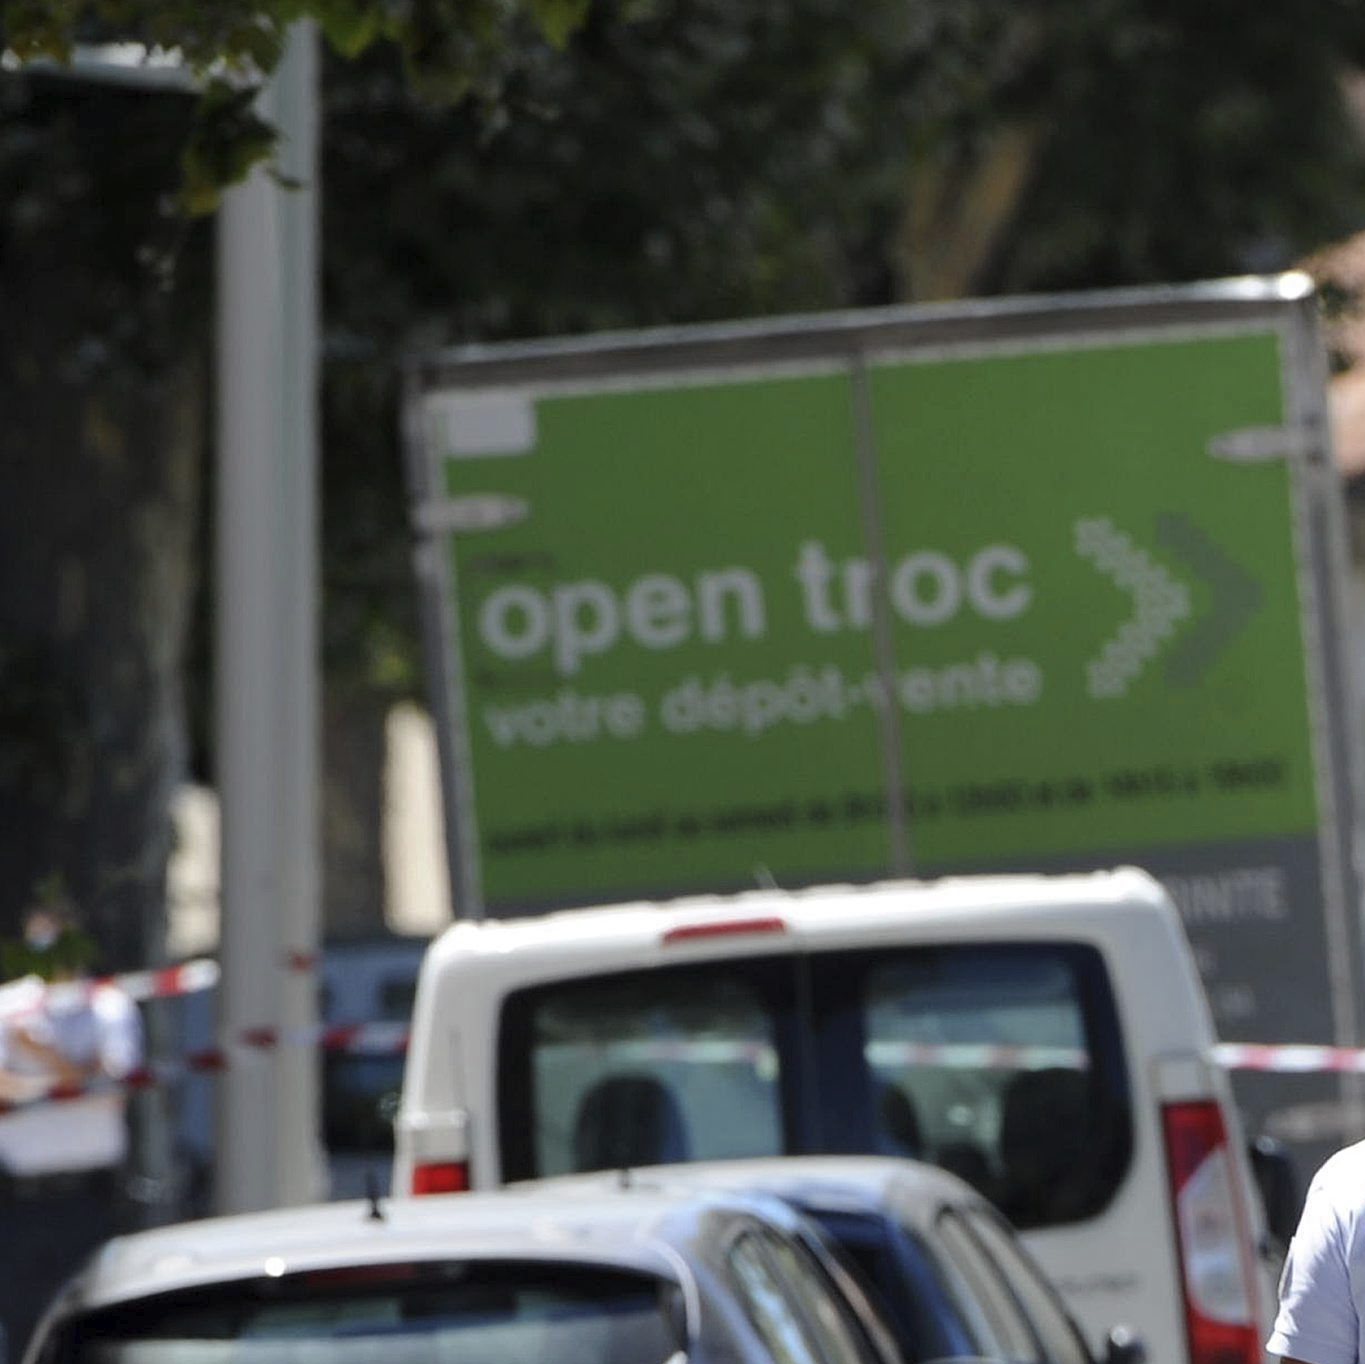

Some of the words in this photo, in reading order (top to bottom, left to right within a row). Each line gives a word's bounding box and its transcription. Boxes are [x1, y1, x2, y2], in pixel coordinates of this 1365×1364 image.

[479, 566, 764, 675] open
[795, 540, 1033, 634] troc
[484, 688, 646, 747] votre
